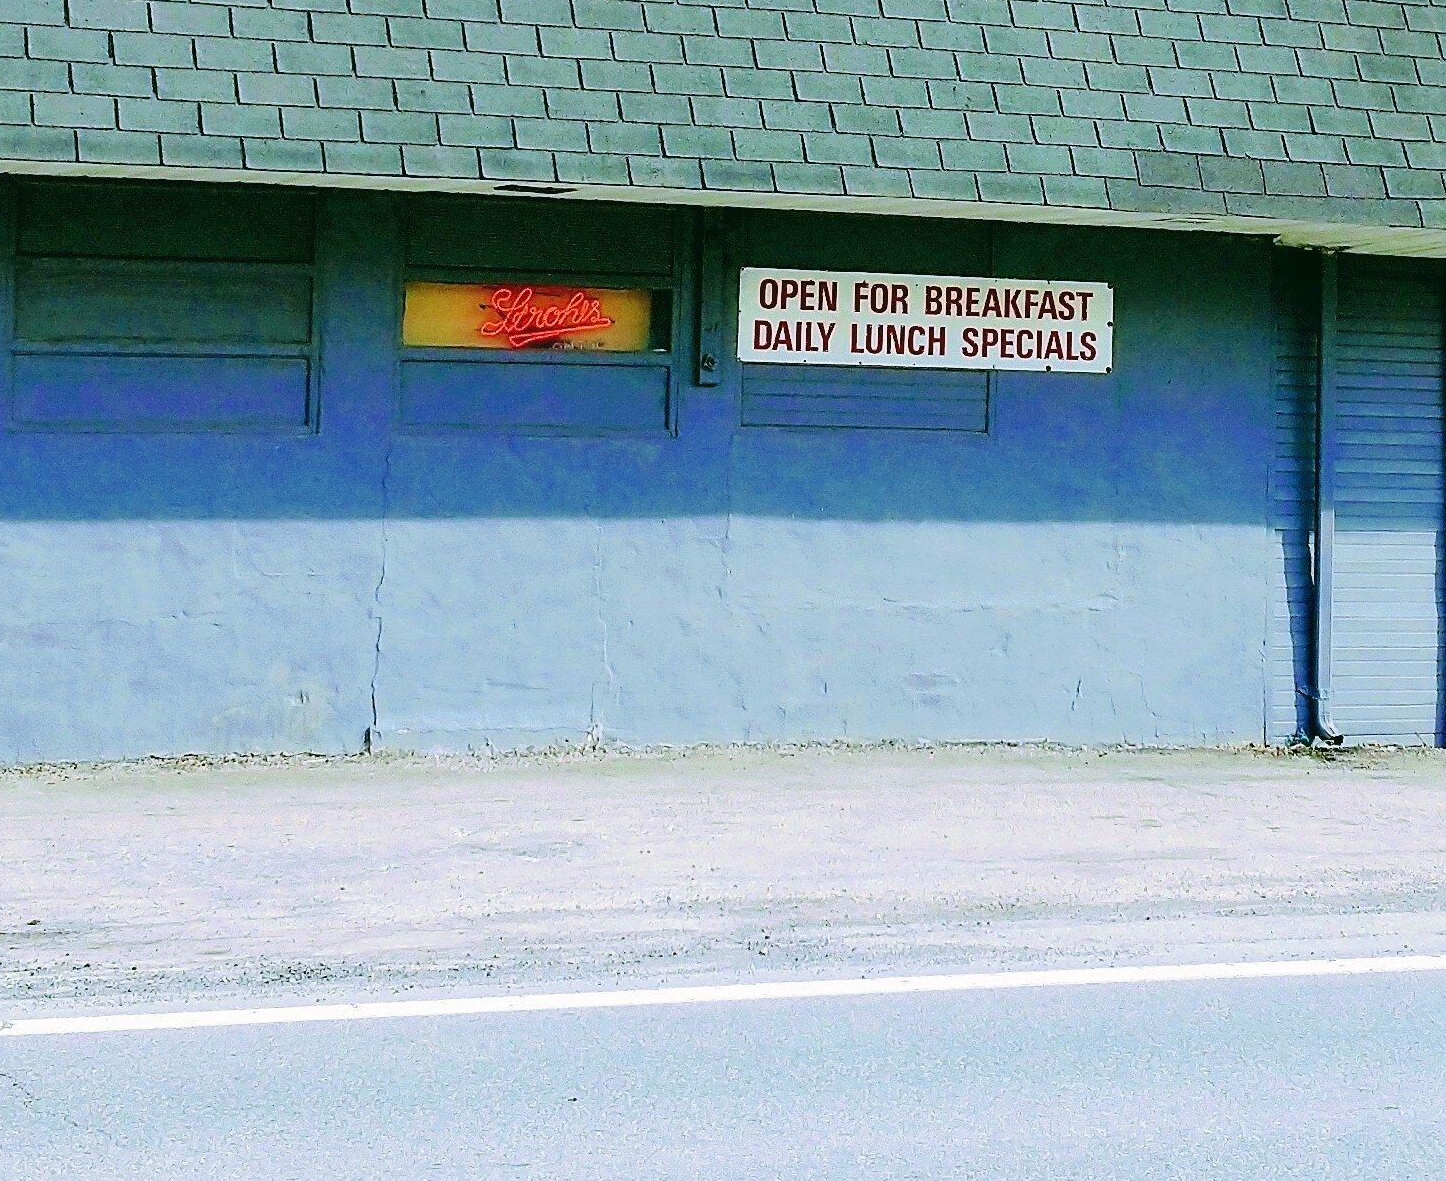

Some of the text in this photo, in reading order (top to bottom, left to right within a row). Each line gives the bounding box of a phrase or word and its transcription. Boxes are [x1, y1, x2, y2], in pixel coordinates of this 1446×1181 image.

[759, 278, 1094, 321] OPEN FOR BREAKFAST
[754, 320, 1097, 361] DAILY LUNCH SPECIALS
